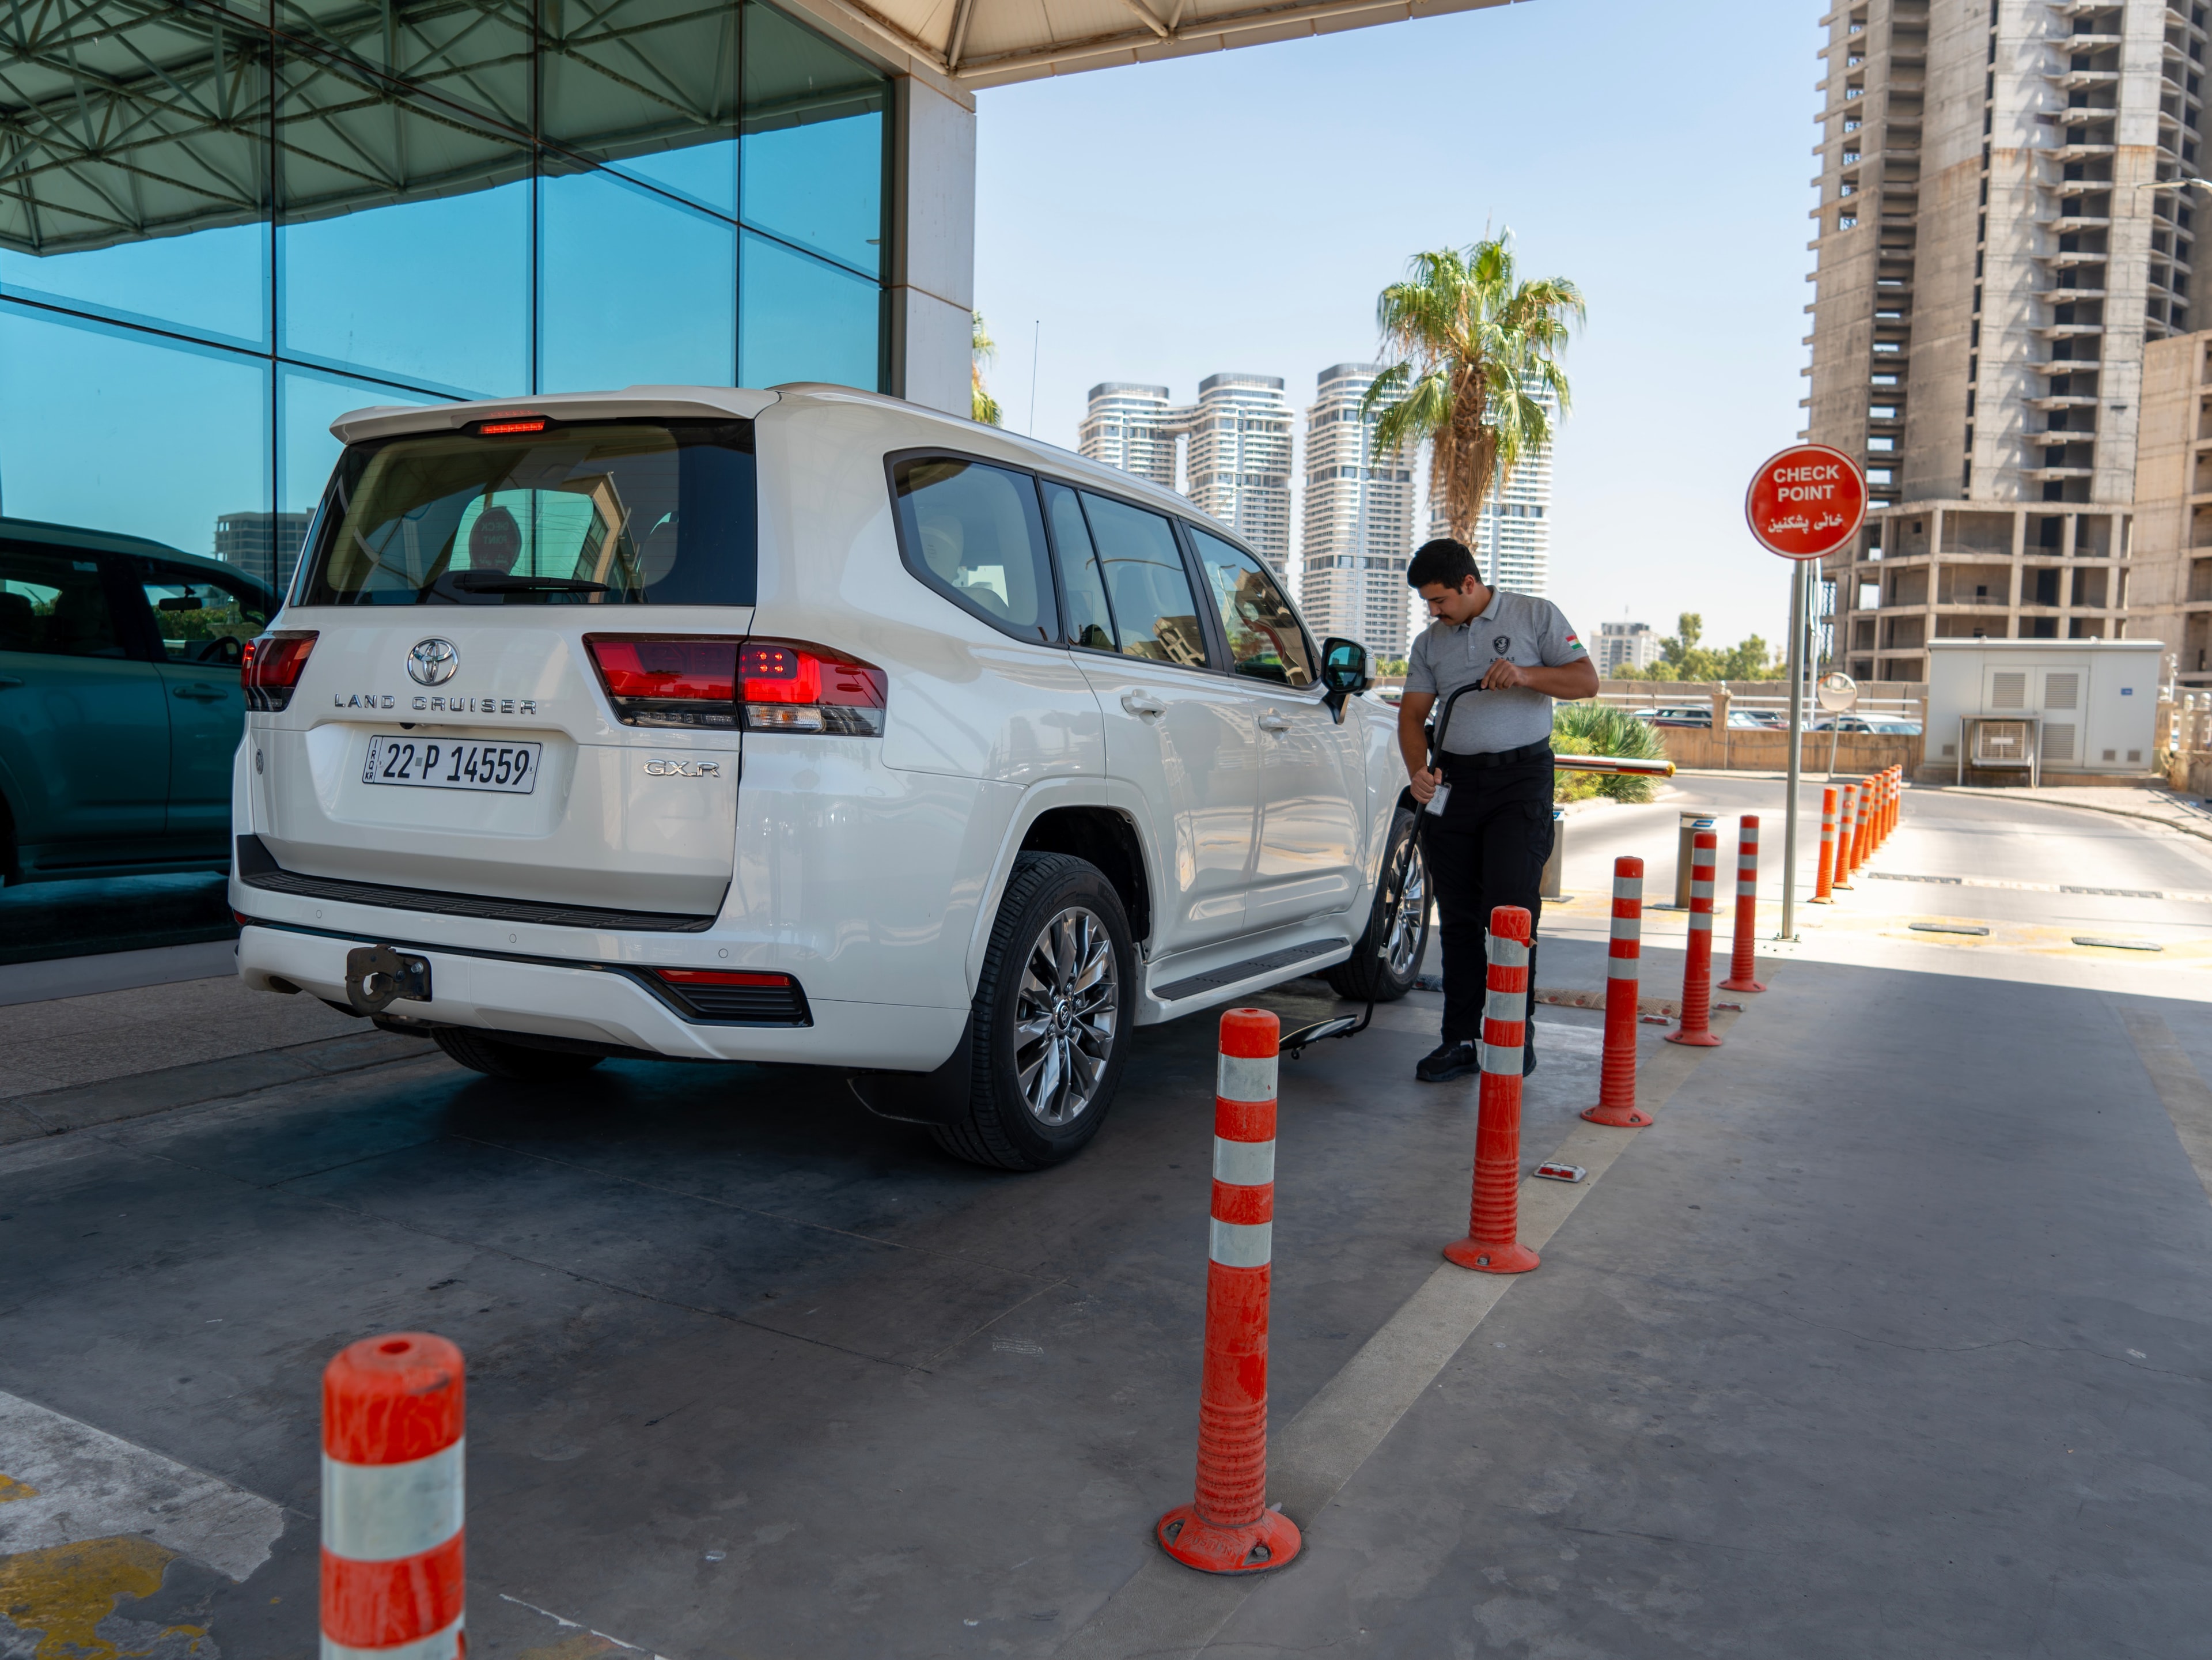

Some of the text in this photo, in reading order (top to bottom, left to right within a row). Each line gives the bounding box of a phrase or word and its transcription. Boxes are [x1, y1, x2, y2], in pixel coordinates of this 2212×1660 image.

[1773, 464, 1839, 483] CHECK
[1778, 485, 1835, 502] POINT
[334, 694, 537, 714] LAND CRUISER
[382, 743, 530, 785] 22 P 14559
